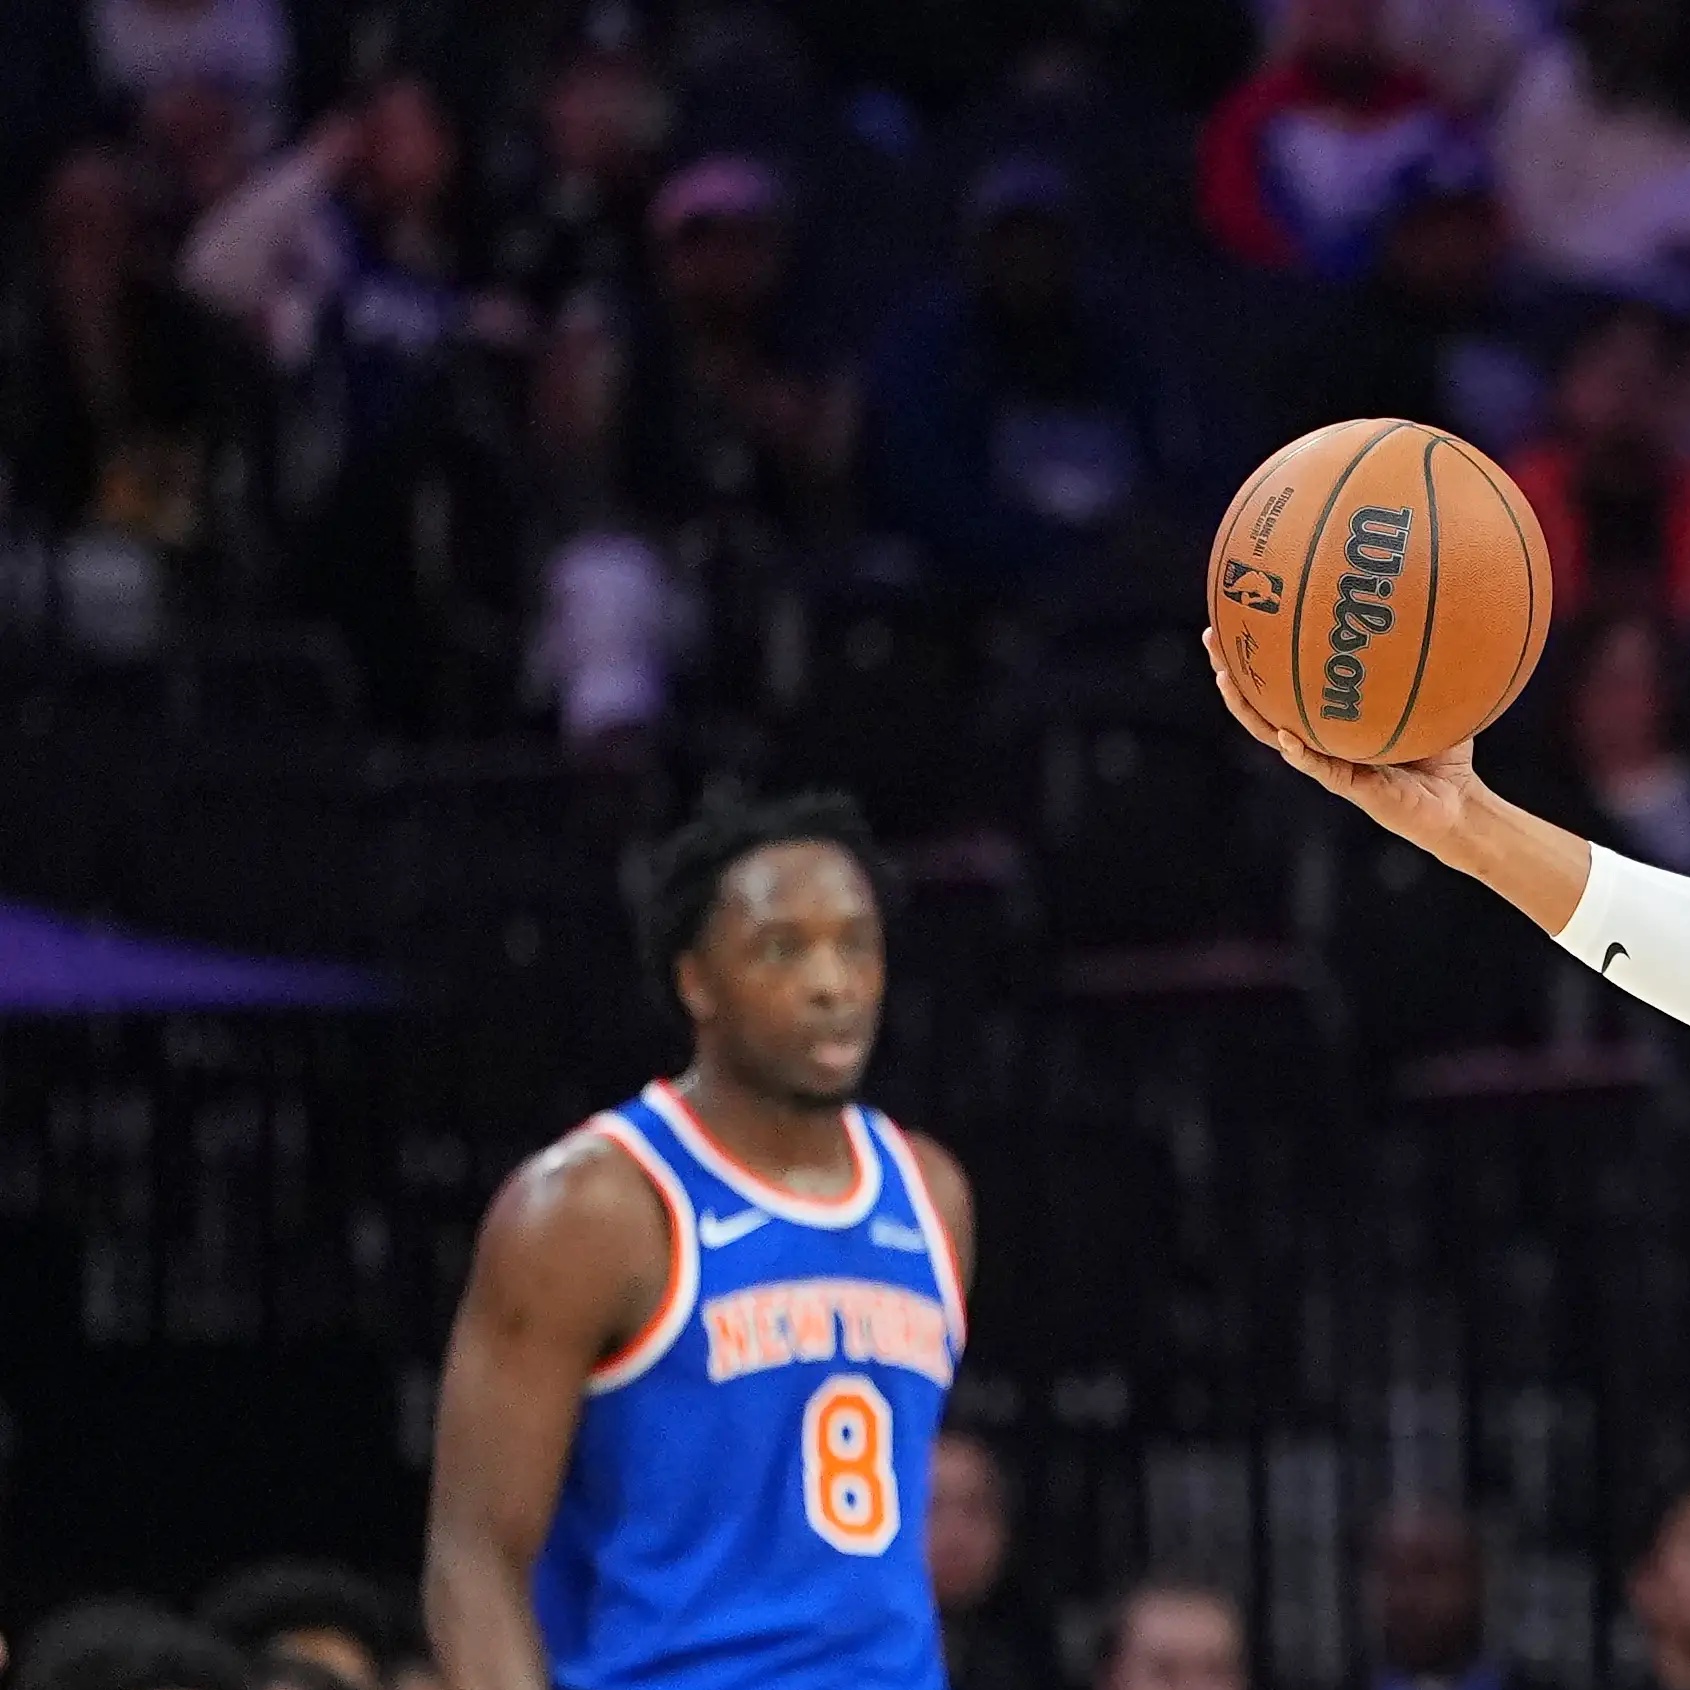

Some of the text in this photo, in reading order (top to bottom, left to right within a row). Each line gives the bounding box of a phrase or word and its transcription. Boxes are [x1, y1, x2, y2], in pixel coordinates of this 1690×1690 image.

[1321, 505, 1414, 722] Wilson
[702, 1279, 836, 1385] NEW
[802, 1373, 901, 1557] 8
